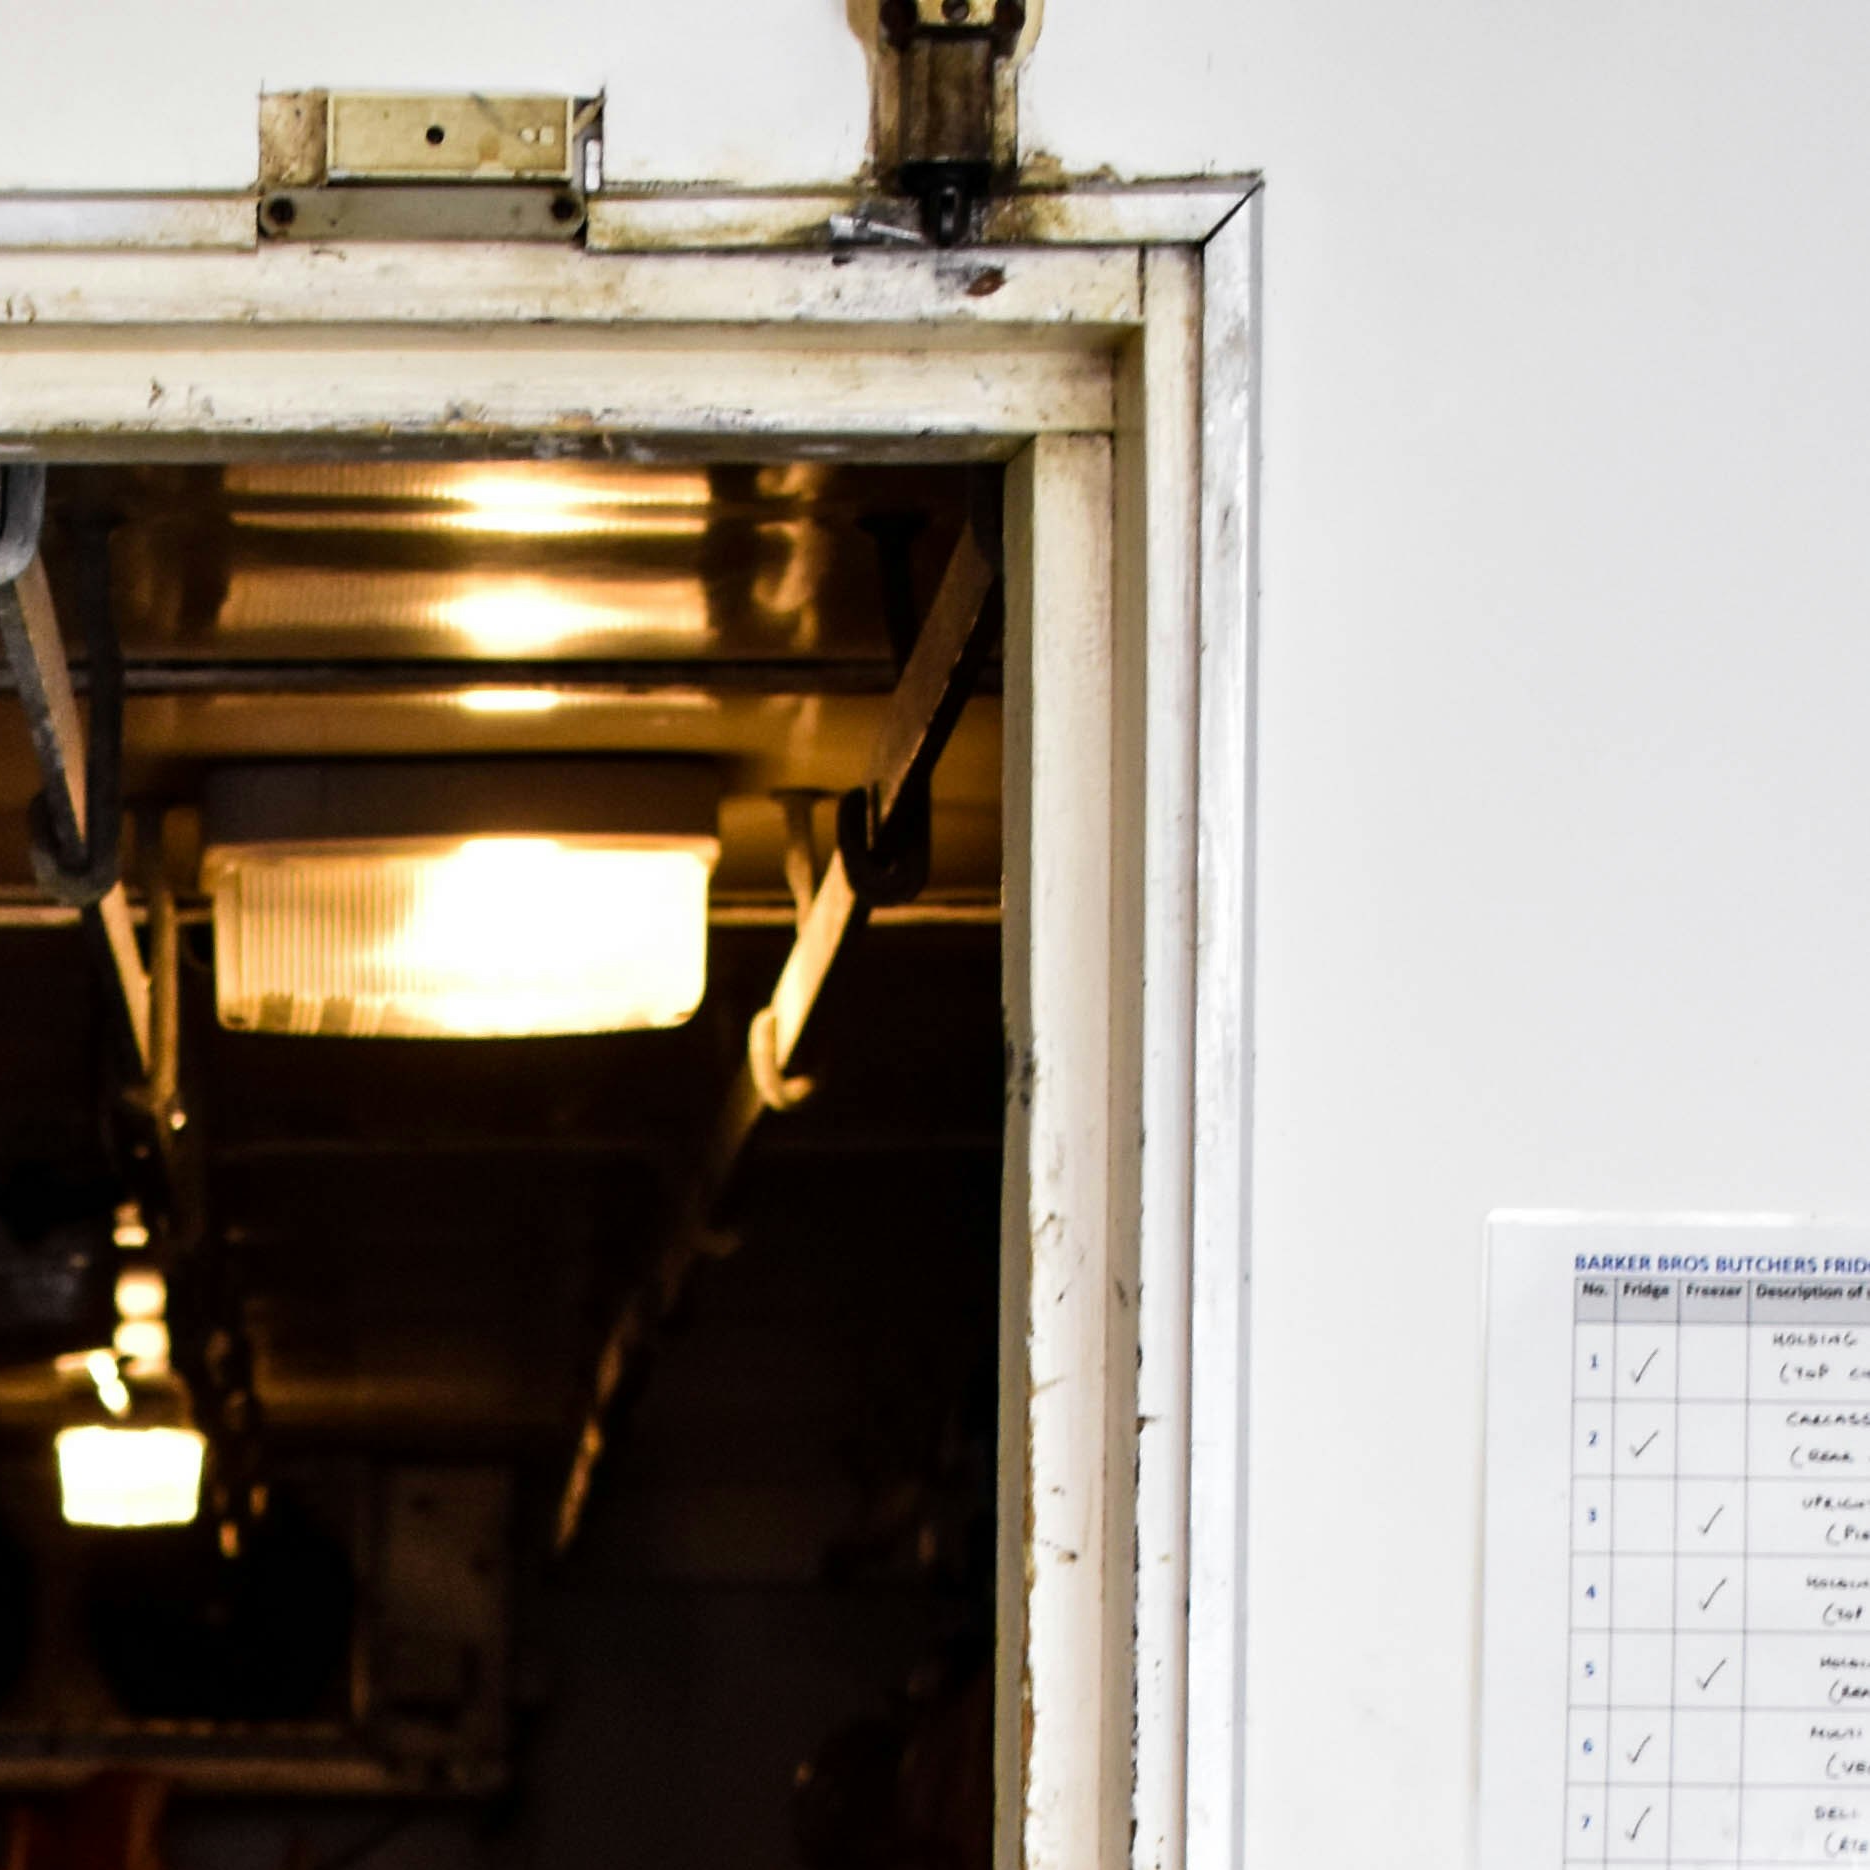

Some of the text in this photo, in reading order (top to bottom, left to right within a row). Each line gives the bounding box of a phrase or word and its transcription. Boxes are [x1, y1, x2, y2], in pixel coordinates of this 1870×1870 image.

[1574, 1255, 1870, 1274] BARKER BROS BUTCHERS FRID
[1623, 1281, 1670, 1300] Fridge
[1686, 1283, 1743, 1297] Freezer
[1755, 1284, 1844, 1301] Description
[1590, 1355, 1600, 1370] 1
[1588, 1432, 1598, 1446] 2
[1588, 1508, 1598, 1523] 3
[1586, 1585, 1598, 1600] 4
[1585, 1662, 1596, 1677] 5
[1583, 1739, 1594, 1754] 6
[1582, 1815, 1592, 1829] 7
